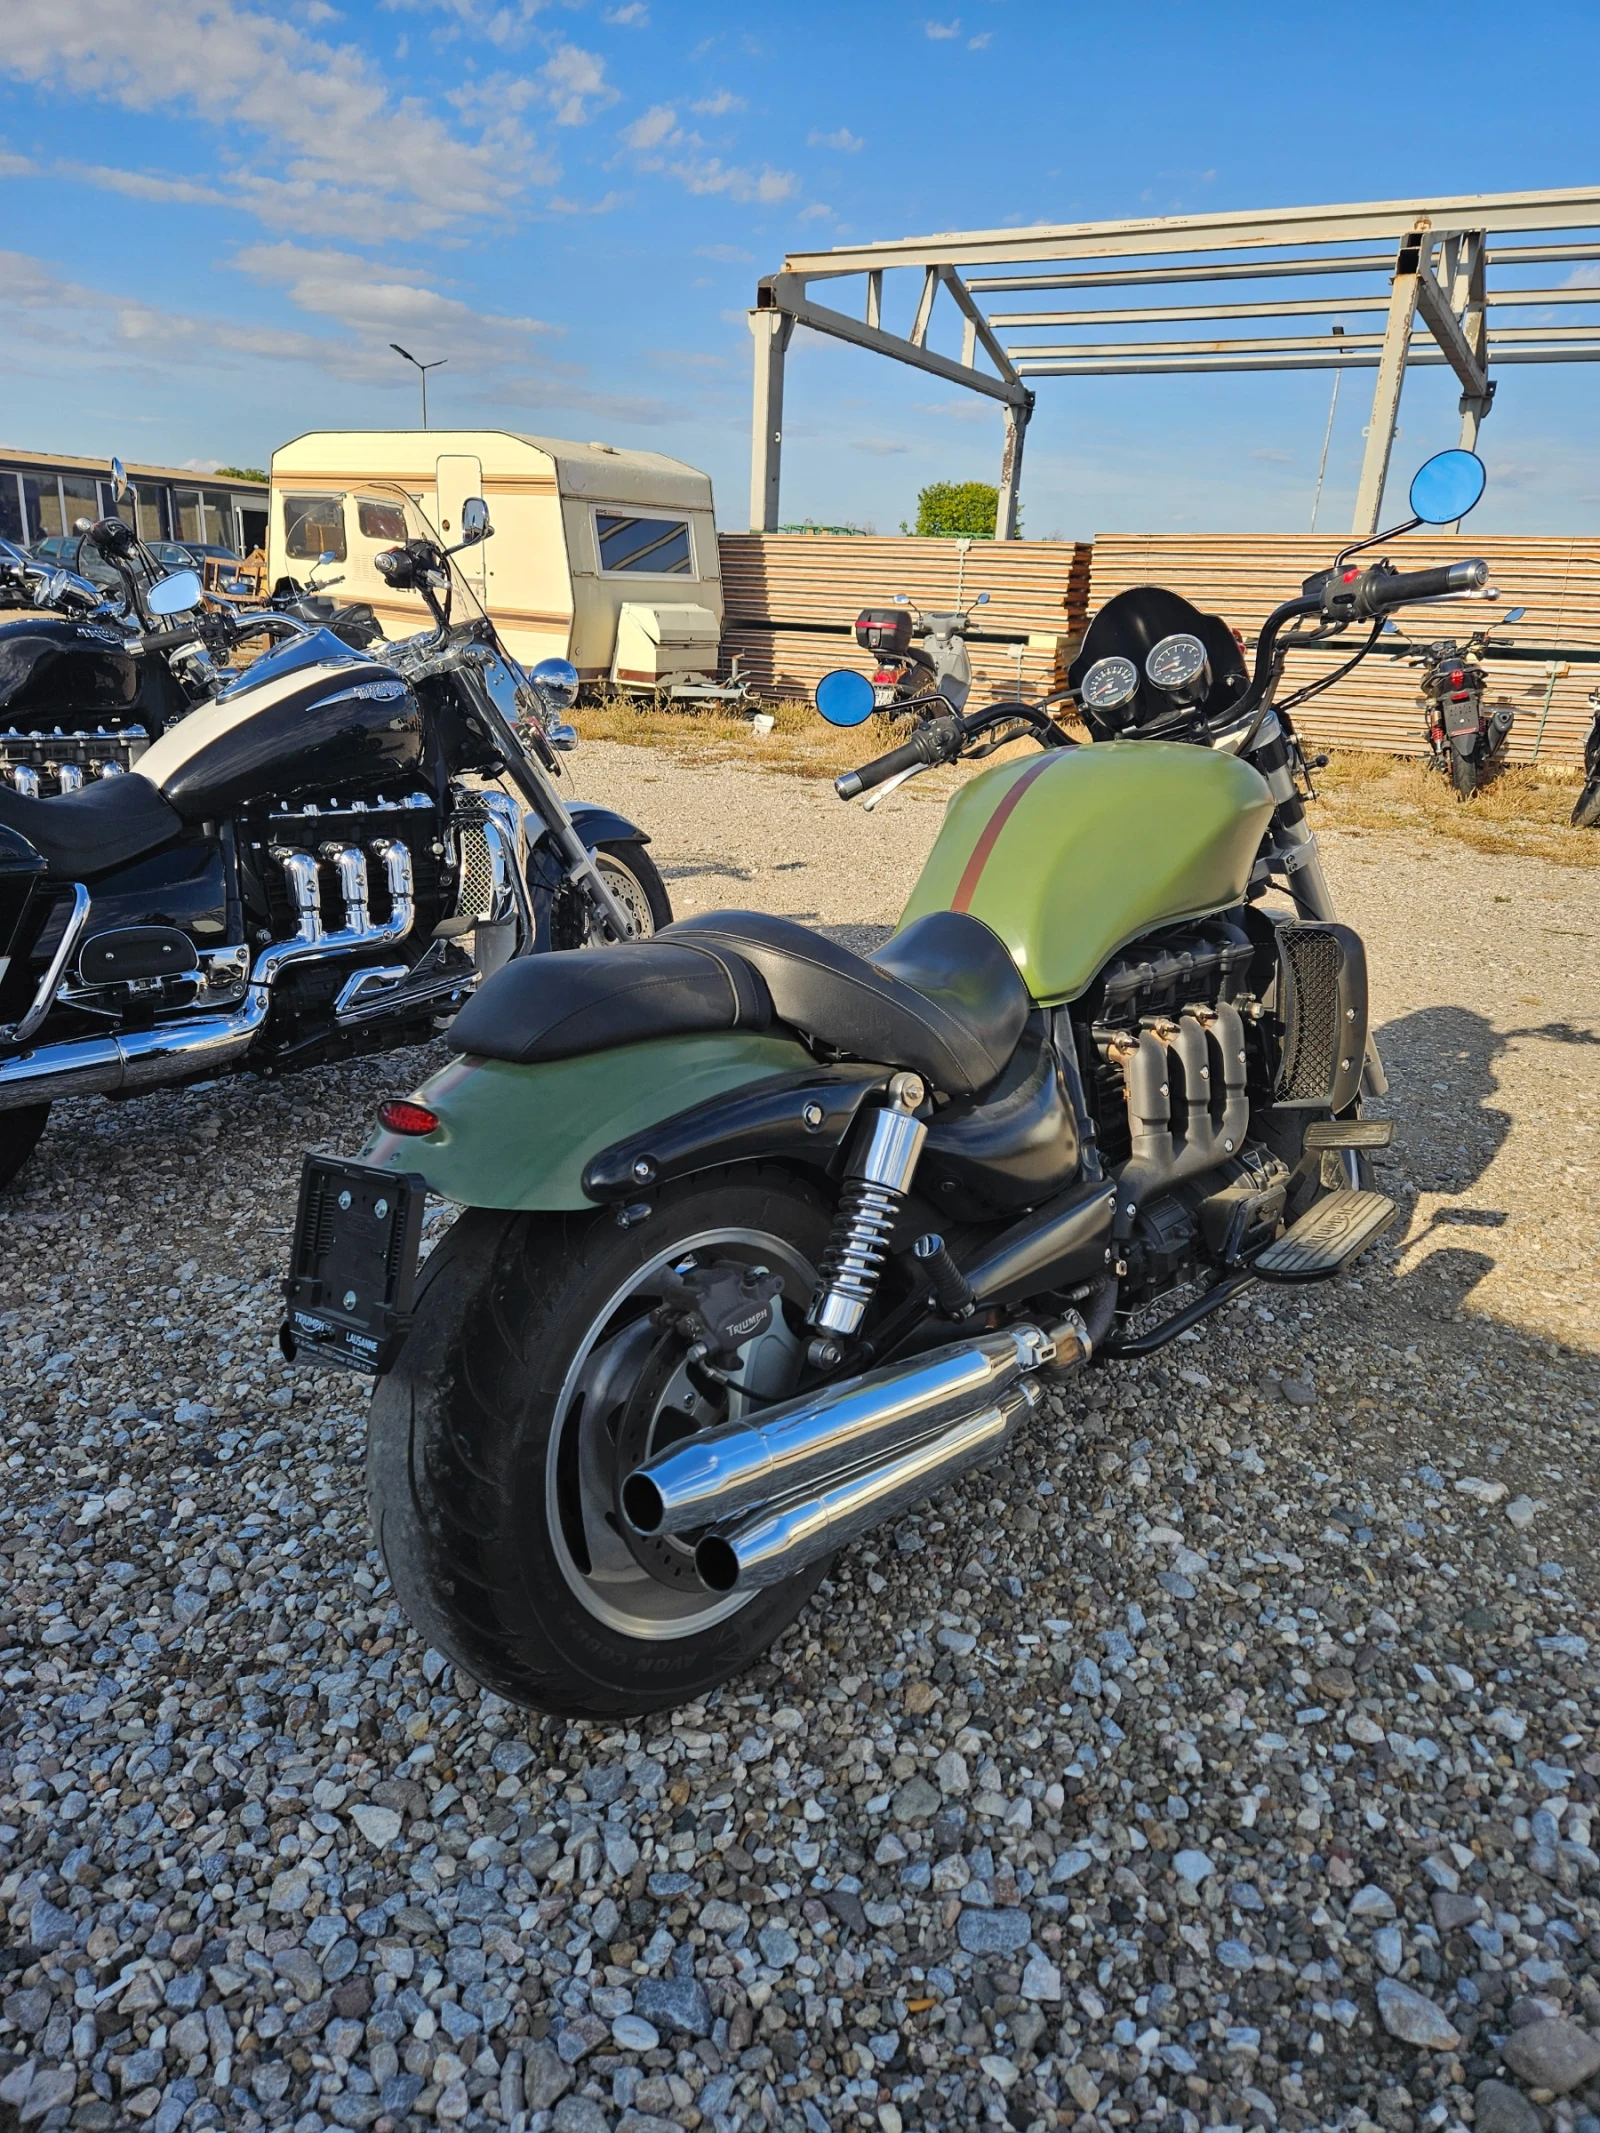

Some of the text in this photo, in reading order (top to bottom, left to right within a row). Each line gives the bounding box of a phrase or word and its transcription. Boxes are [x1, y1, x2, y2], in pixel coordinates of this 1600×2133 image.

[1297, 1206, 1355, 1249] TRIUMPH
[294, 1311, 325, 1333] TRIUMPH
[726, 1309, 768, 1337] TRIUMPH
[345, 1331, 378, 1353] LAUSANNE
[633, 1651, 700, 1673] AVON
